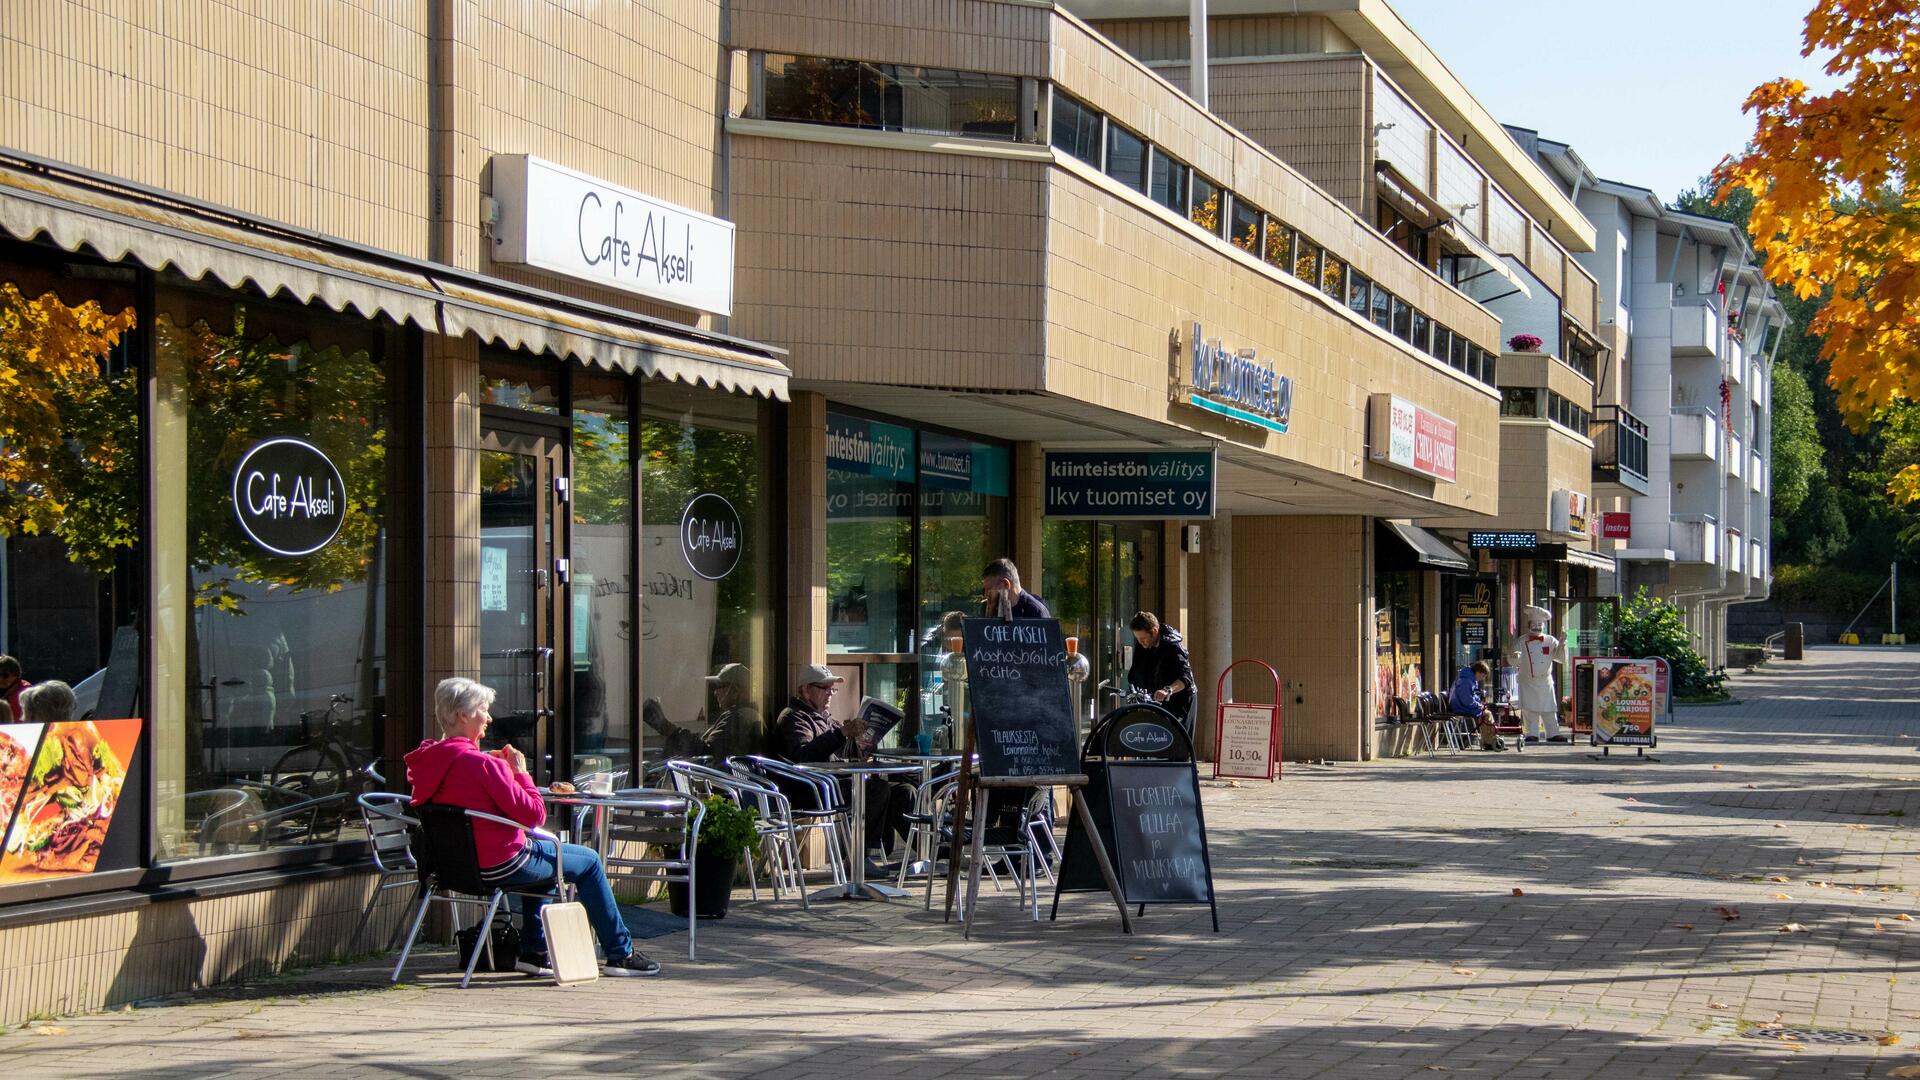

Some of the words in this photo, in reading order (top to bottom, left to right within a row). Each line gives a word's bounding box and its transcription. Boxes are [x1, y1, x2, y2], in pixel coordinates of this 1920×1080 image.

[579, 192, 631, 277] Cafe
[636, 210, 693, 284] Akseli
[826, 425, 905, 477] inteistönvälitys
[920, 452, 971, 474] www.tuomiset.fi
[1051, 460, 1205, 480] kiinteistönvälitys
[247, 471, 287, 519] Cafe
[291, 475, 335, 518] Akseli
[1050, 486, 1080, 506] lkv
[1086, 487, 1176, 506] tuomiset
[1183, 491, 1207, 510] oy
[688, 517, 710, 552] Cafe
[712, 520, 737, 552] Akseli
[1605, 524, 1629, 532] instru
[983, 625, 1011, 643] CAFE
[1012, 625, 1048, 644] AKSELI
[1125, 731, 1145, 744] Cafe
[1121, 786, 1183, 808] TUORETTA
[1139, 812, 1184, 834] PULLAA
[1151, 839, 1162, 859] ja
